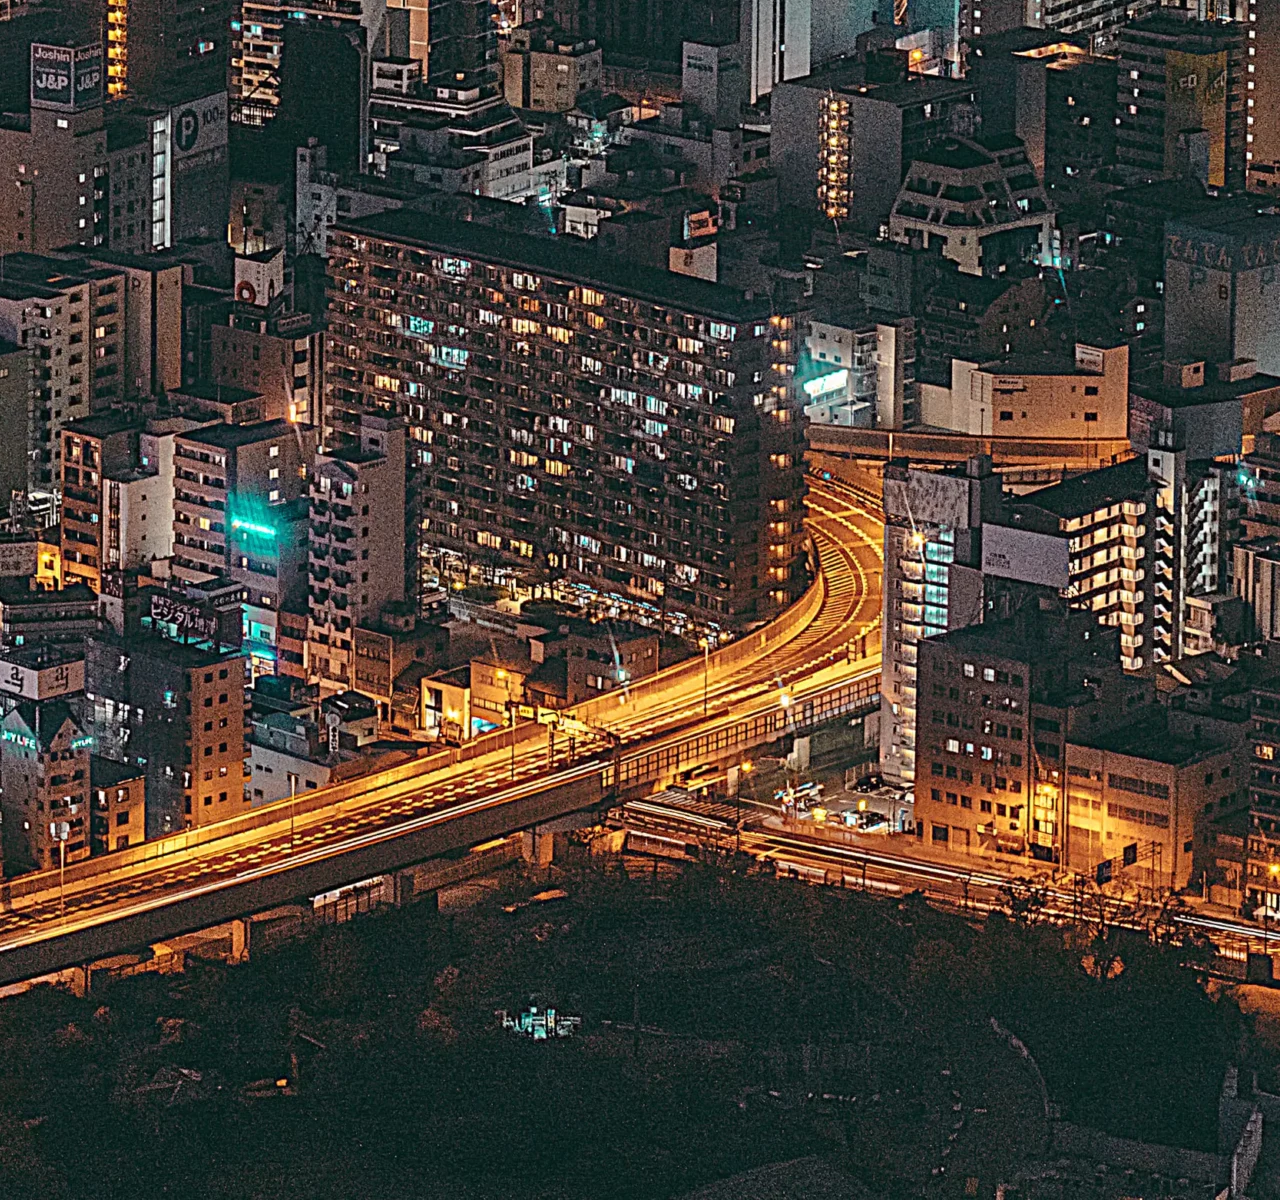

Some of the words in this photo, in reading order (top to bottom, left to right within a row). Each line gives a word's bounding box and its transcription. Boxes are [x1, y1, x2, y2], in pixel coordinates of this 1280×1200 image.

[35, 47, 72, 62] Joshin
[74, 47, 102, 63] Joshin
[36, 73, 69, 90] J&P
[77, 72, 100, 92] J&P
